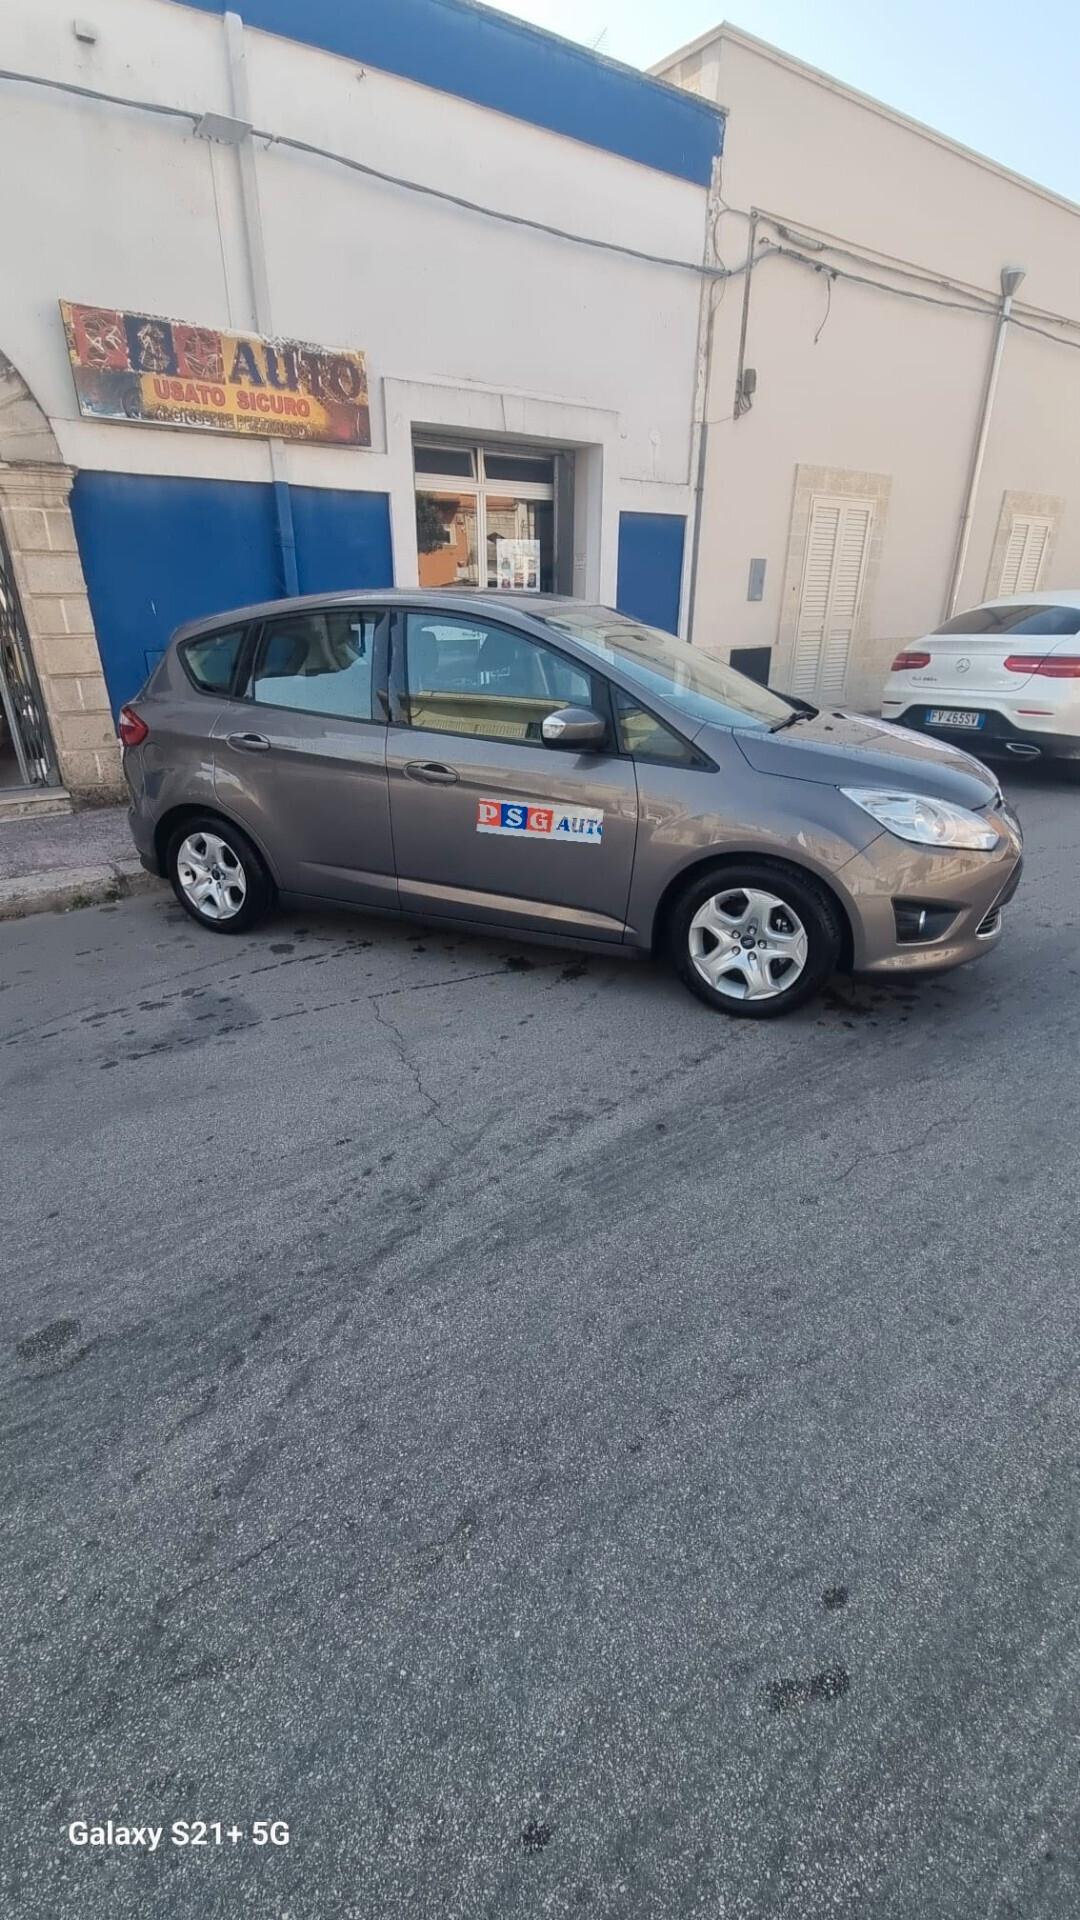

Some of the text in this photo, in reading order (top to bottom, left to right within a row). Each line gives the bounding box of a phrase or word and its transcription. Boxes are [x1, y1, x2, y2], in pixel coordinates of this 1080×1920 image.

[229, 340, 362, 400] AUTO
[153, 378, 311, 417] USATO SICURO
[478, 803, 549, 830] PSG
